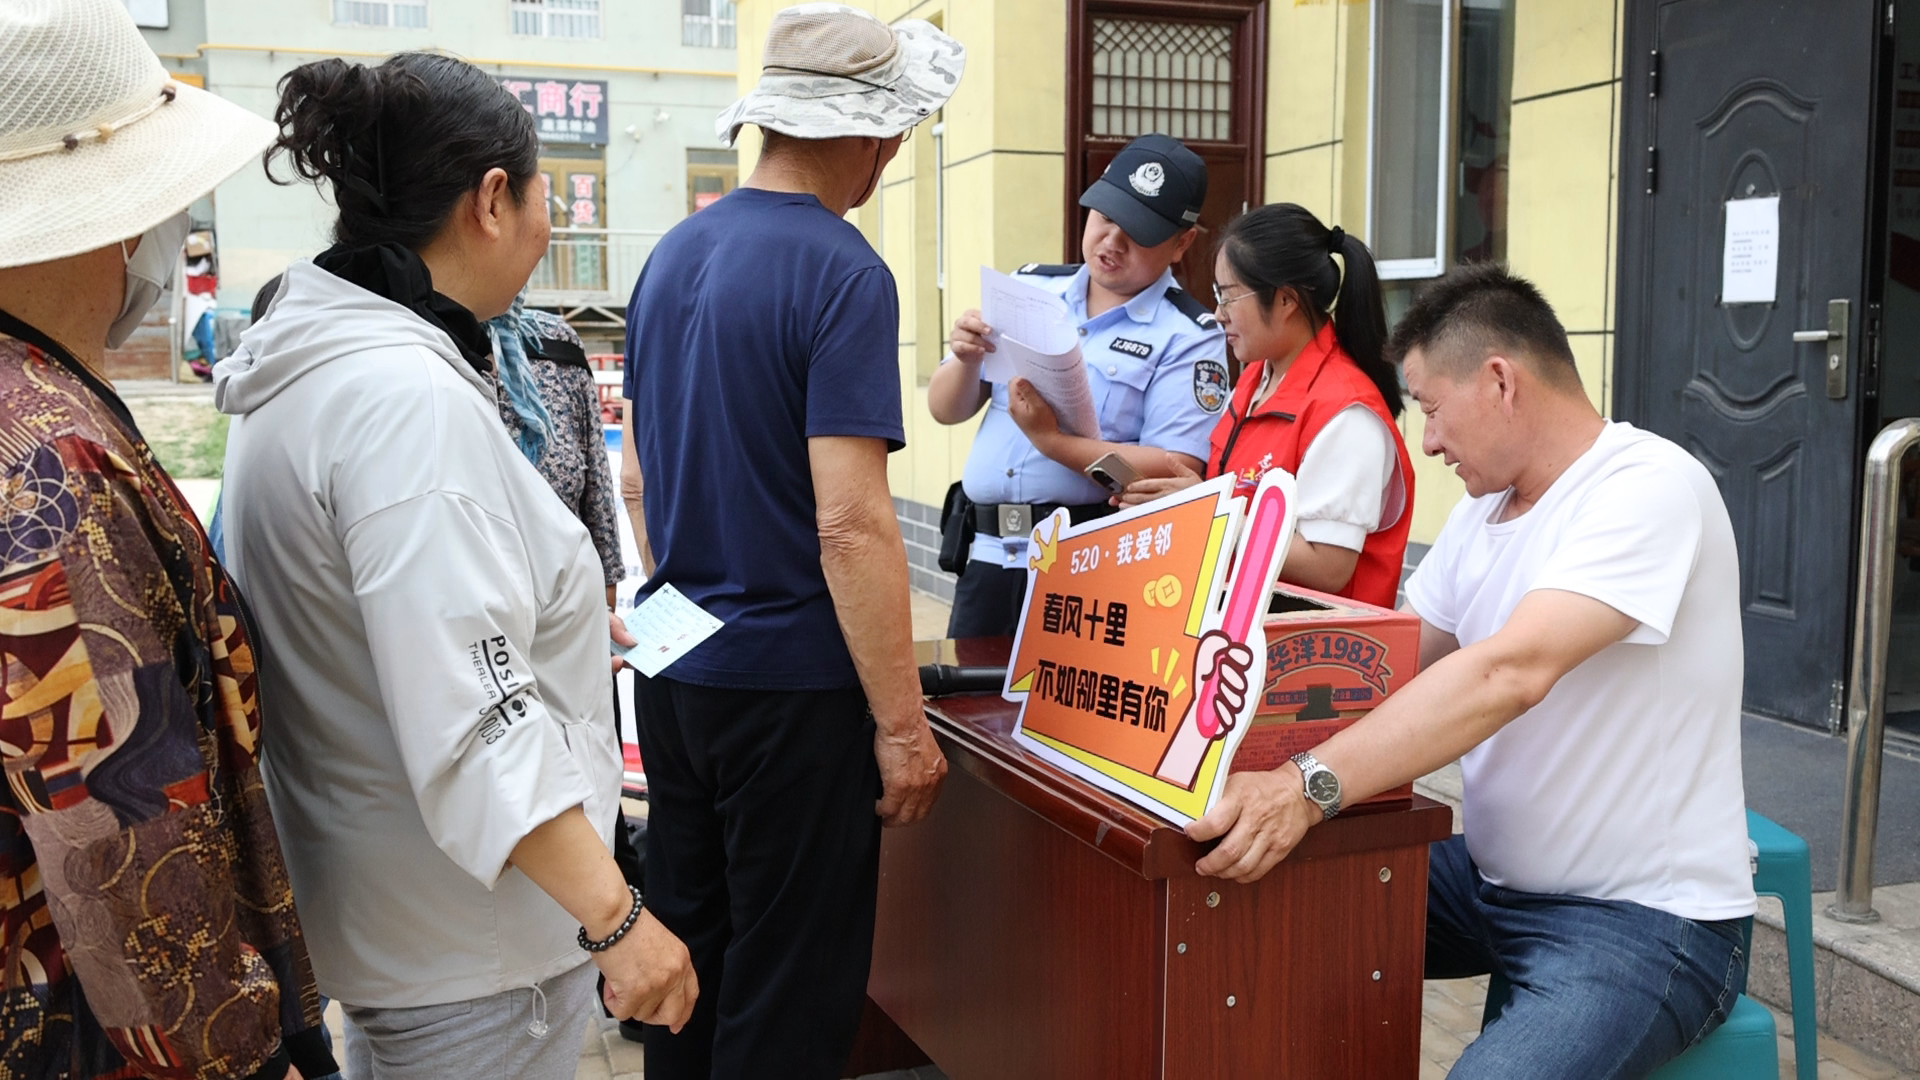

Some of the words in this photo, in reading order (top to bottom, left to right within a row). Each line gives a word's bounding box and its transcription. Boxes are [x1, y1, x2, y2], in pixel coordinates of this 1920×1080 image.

[571, 174, 596, 224] 百货
[1112, 339, 1150, 356] XJ6879
[1042, 593, 1128, 647] 春风十里
[1035, 659, 1170, 733] 不如邻里有你
